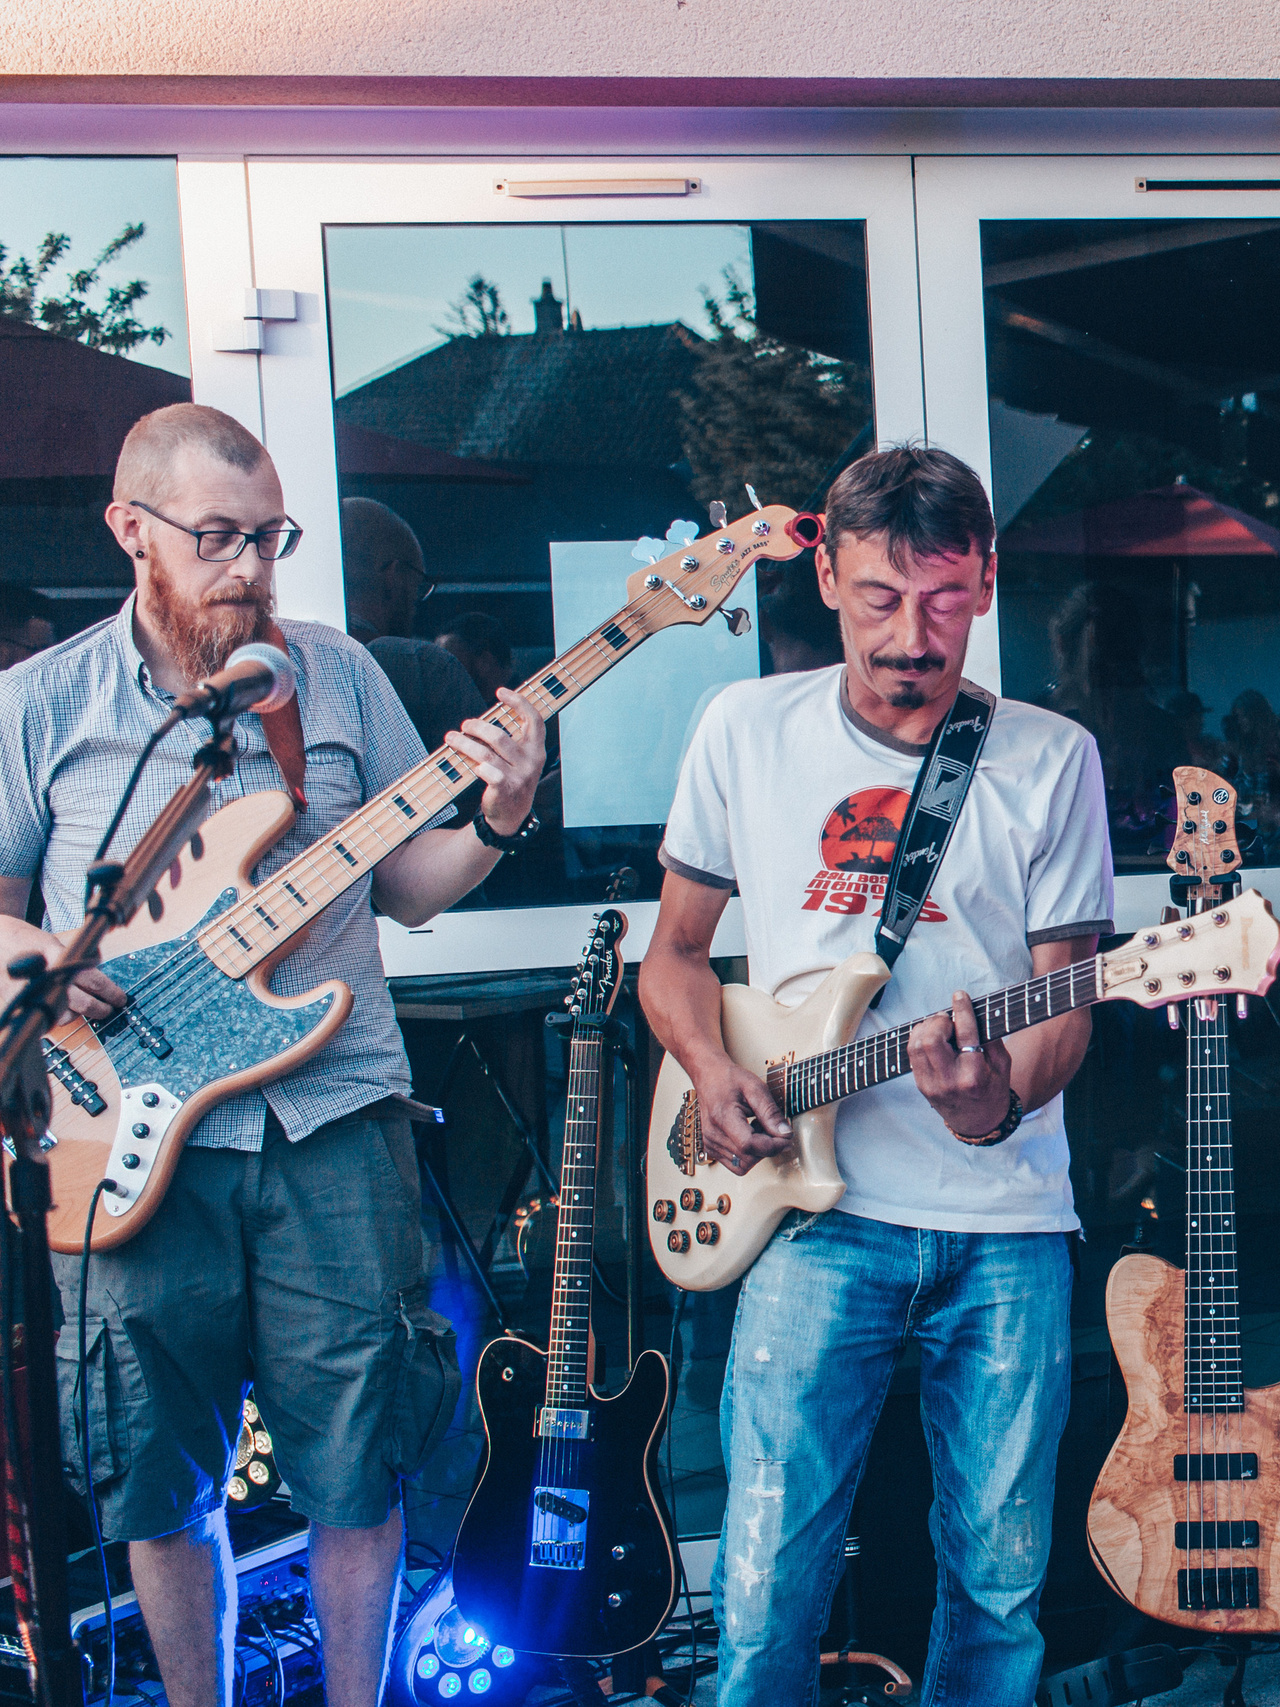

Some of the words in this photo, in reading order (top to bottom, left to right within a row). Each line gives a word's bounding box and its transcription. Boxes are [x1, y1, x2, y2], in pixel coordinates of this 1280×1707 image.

[741, 547, 752, 559] JAZZ
[753, 541, 769, 550] BASS
[946, 716, 984, 735] Fender
[903, 842, 939, 867] Fender
[599, 949, 614, 993] Fender
